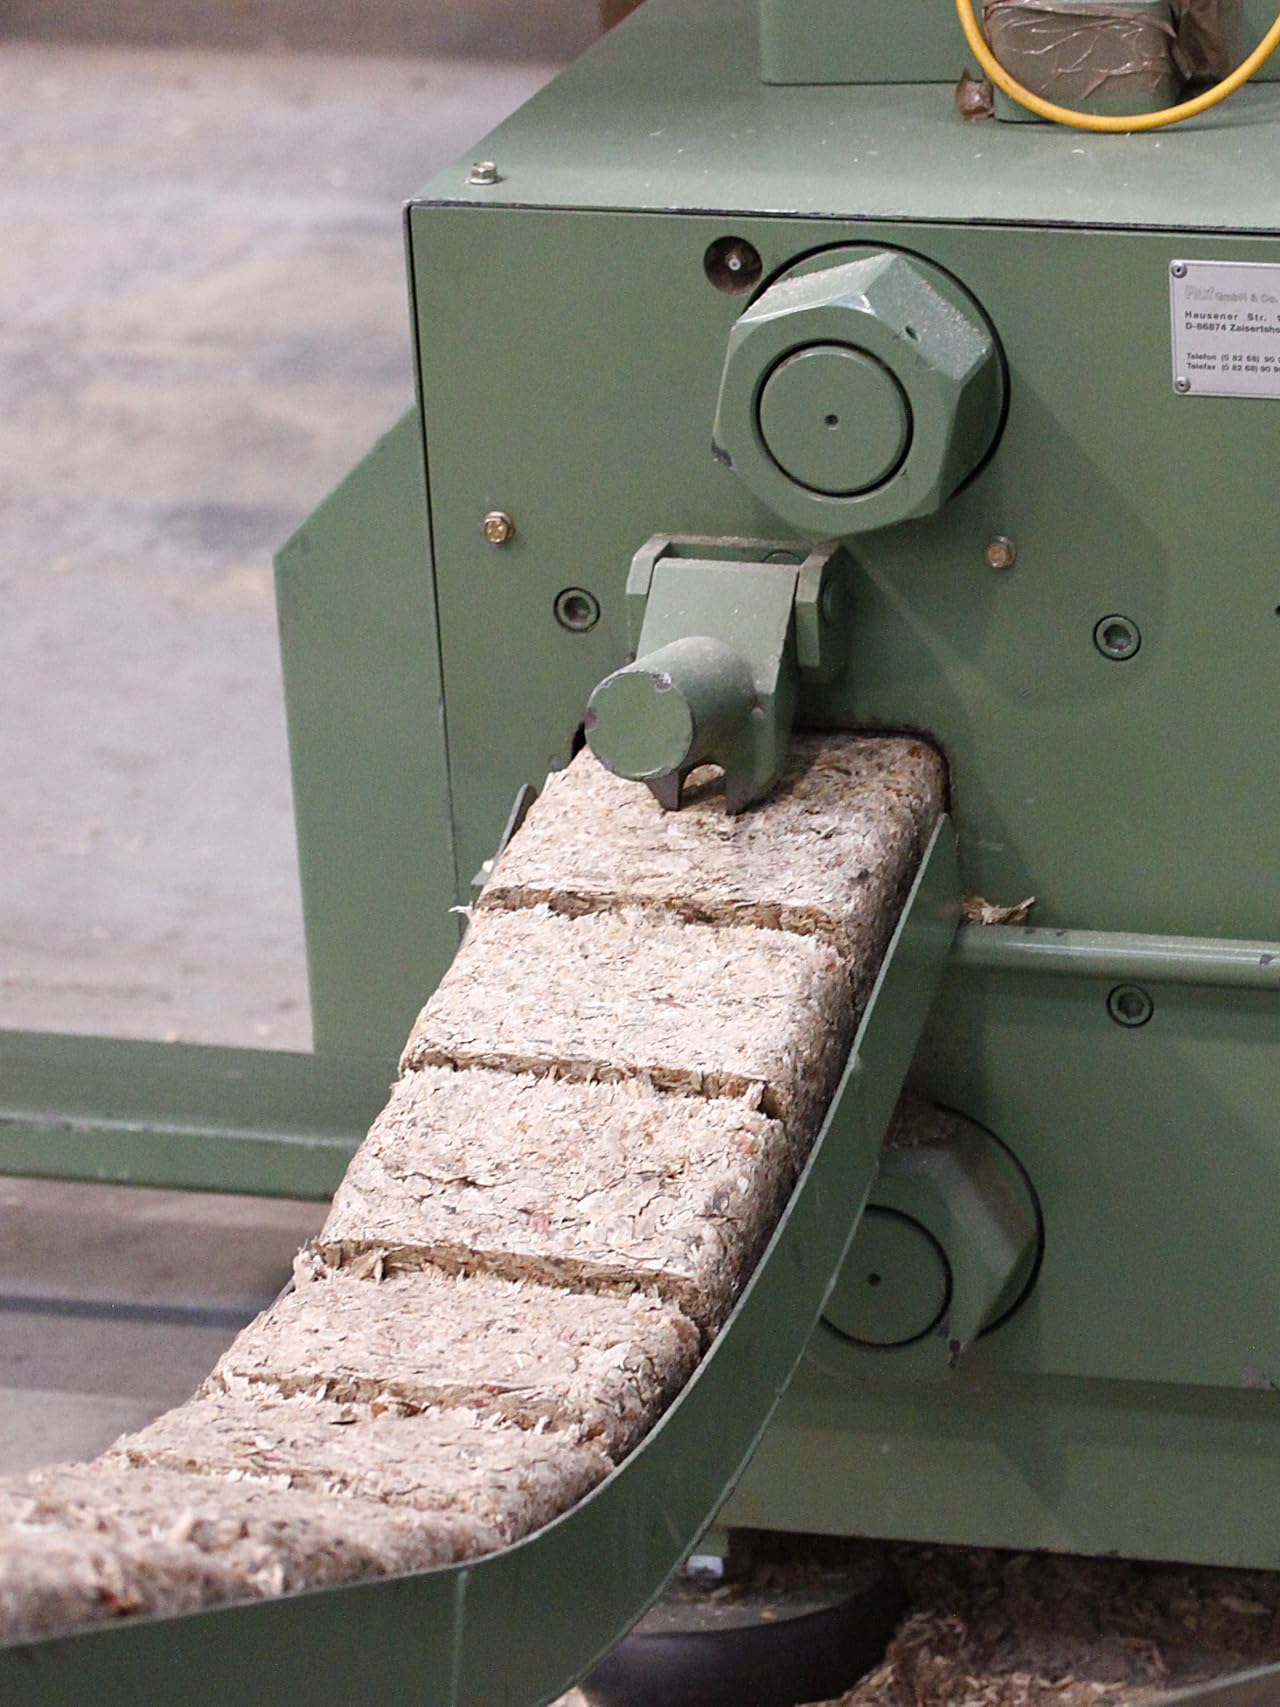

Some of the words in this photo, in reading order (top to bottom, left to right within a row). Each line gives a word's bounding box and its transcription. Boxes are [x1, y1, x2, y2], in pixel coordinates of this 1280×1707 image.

[1184, 310, 1239, 320] Hausener
[1247, 312, 1267, 322] Str.
[1186, 352, 1217, 361] Telefon
[1186, 362, 1216, 371] Telefax
